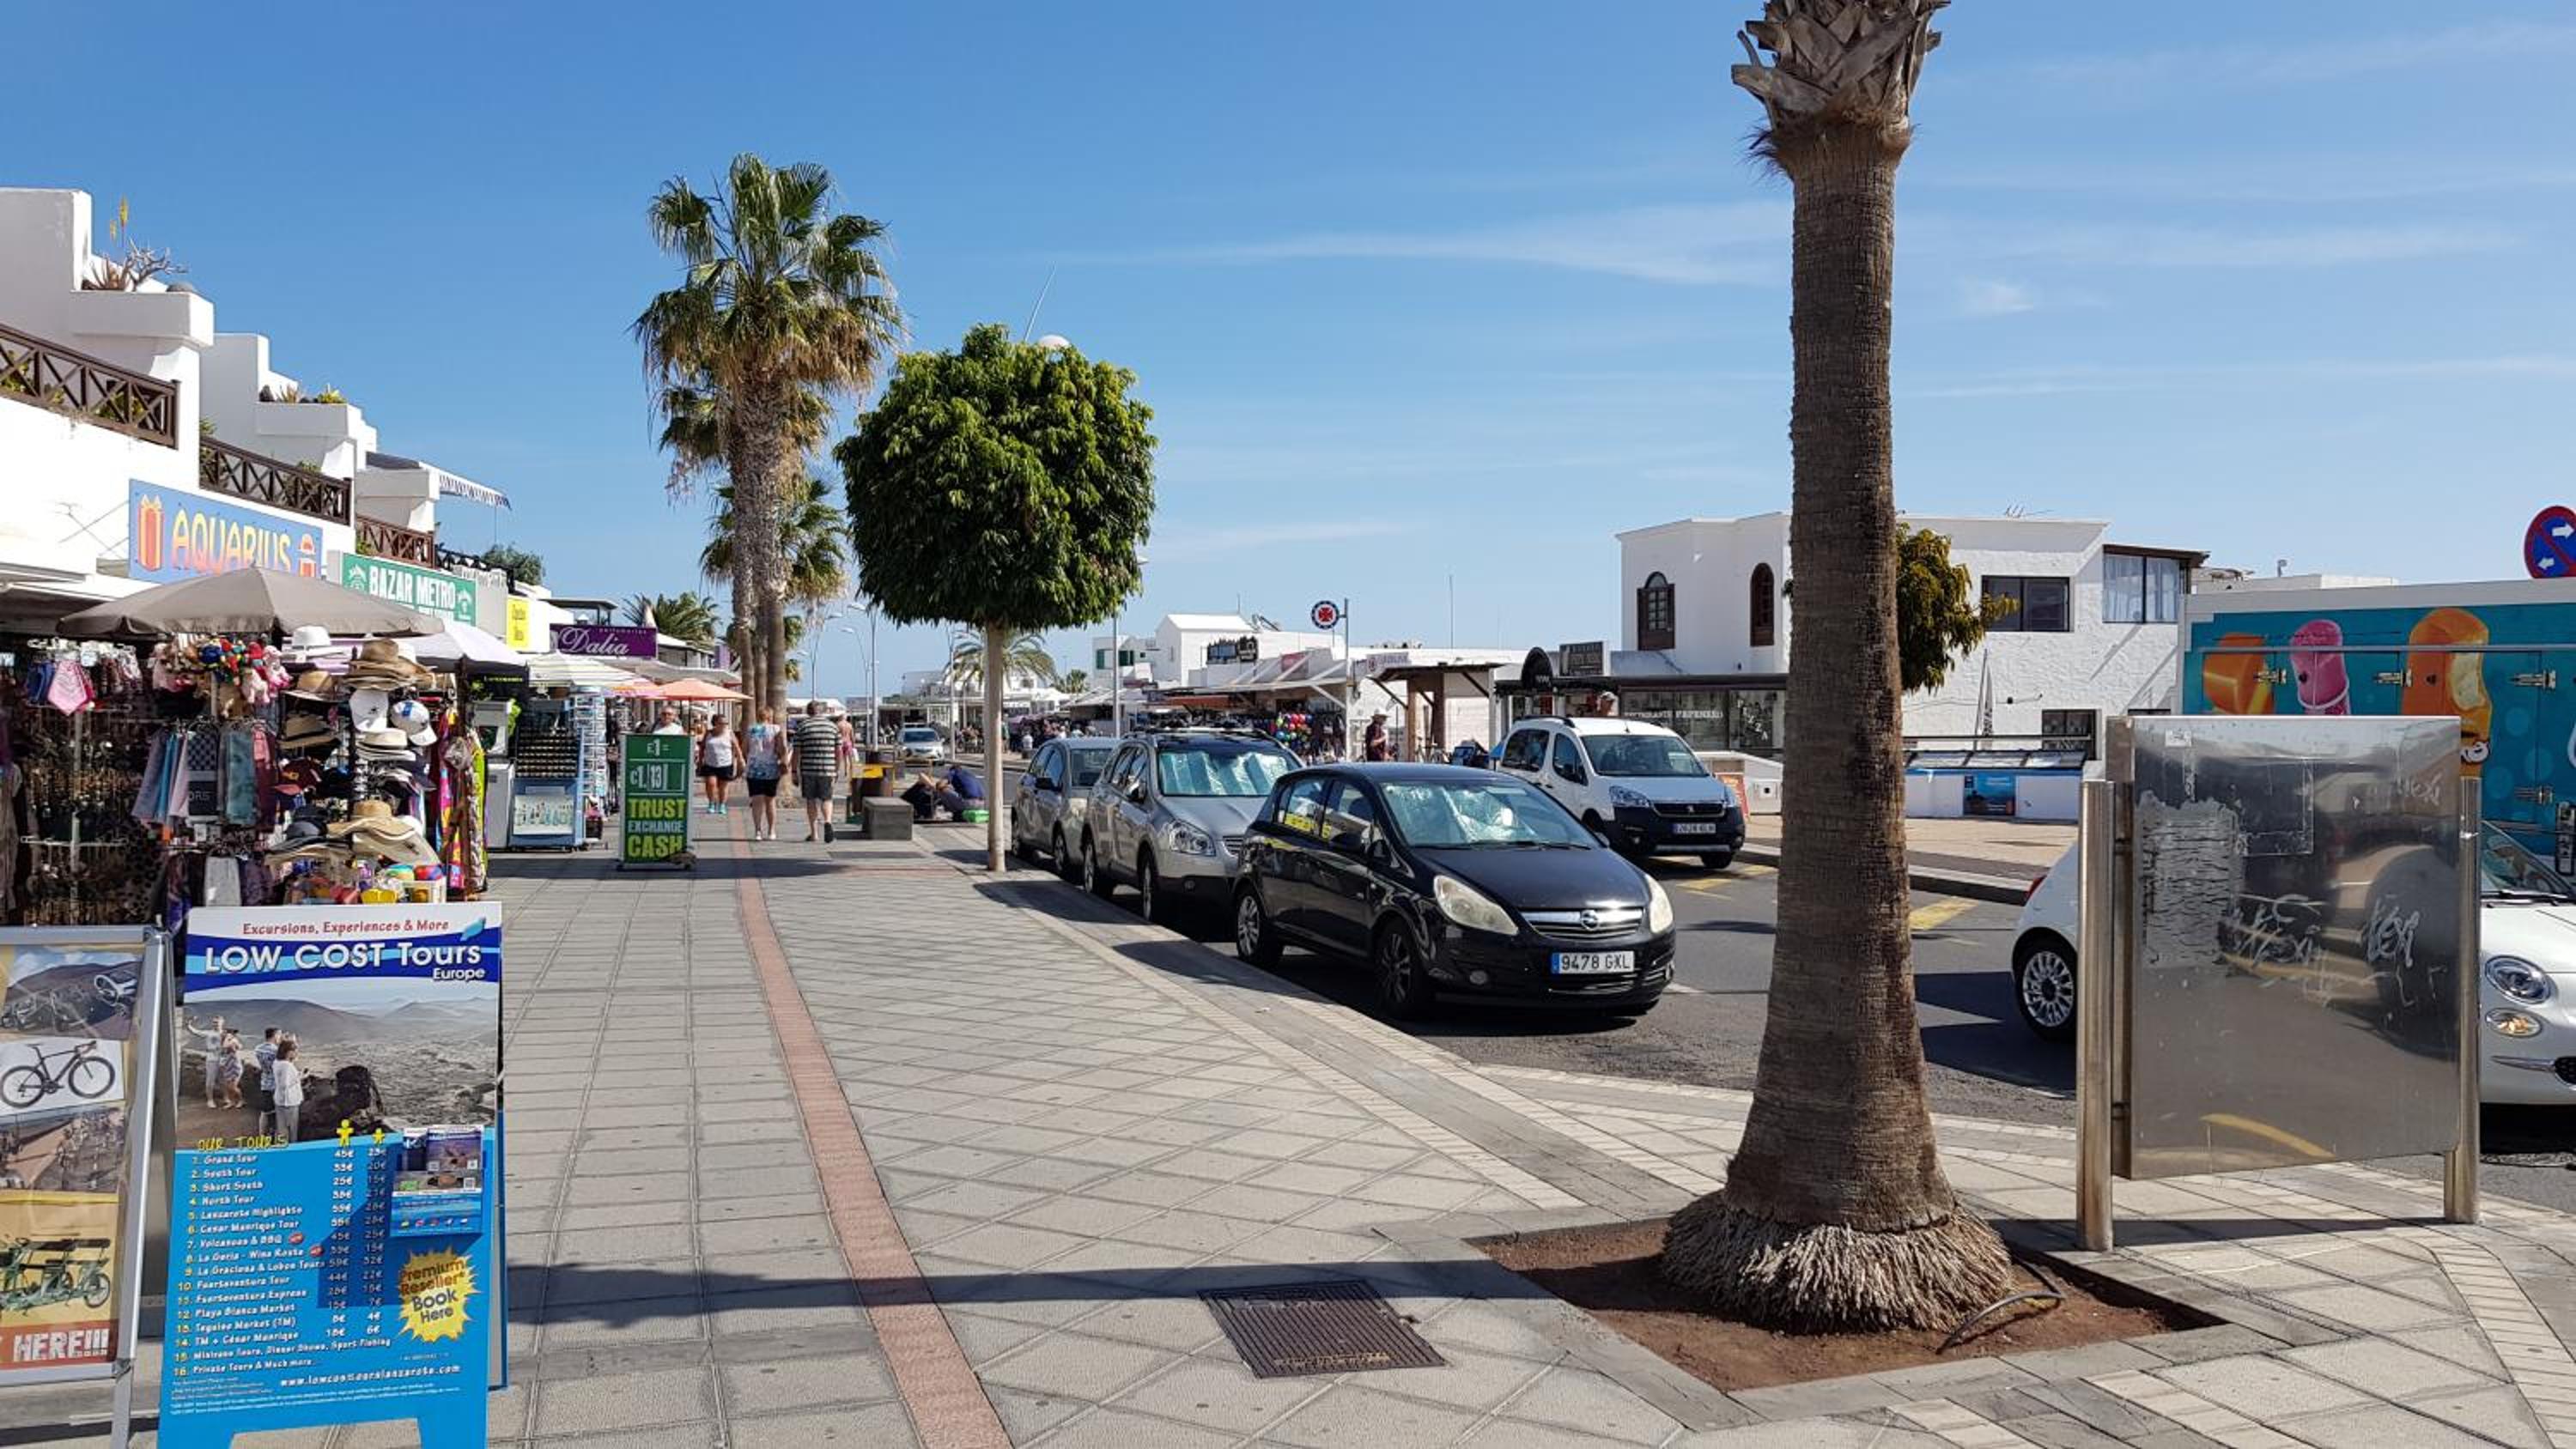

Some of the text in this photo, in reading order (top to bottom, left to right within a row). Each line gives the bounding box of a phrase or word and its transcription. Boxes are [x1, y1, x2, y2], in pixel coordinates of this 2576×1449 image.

[172, 507, 291, 577] AQUARIUS
[368, 565, 456, 609] BAZAR METRO
[559, 627, 630, 655] Dalia
[628, 798, 686, 820] TRUST
[628, 820, 684, 834] EXCHANGE
[628, 835, 683, 858] CASH
[243, 919, 449, 938] Excursions, Experiences & More
[205, 941, 482, 973] LOW COST Tours
[1562, 954, 1631, 971] 9478 GXL
[433, 967, 486, 981] Europe
[197, 1138, 225, 1152] OUR
[236, 1154, 258, 1163] Tour
[236, 1167, 257, 1177] Tour
[234, 1194, 255, 1204] Tour
[278, 1220, 300, 1229] Tour
[401, 1259, 465, 1282] Premium
[412, 1288, 459, 1312] Book
[420, 1307, 454, 1323] Here
[14, 1328, 110, 1362] HERE!!!
